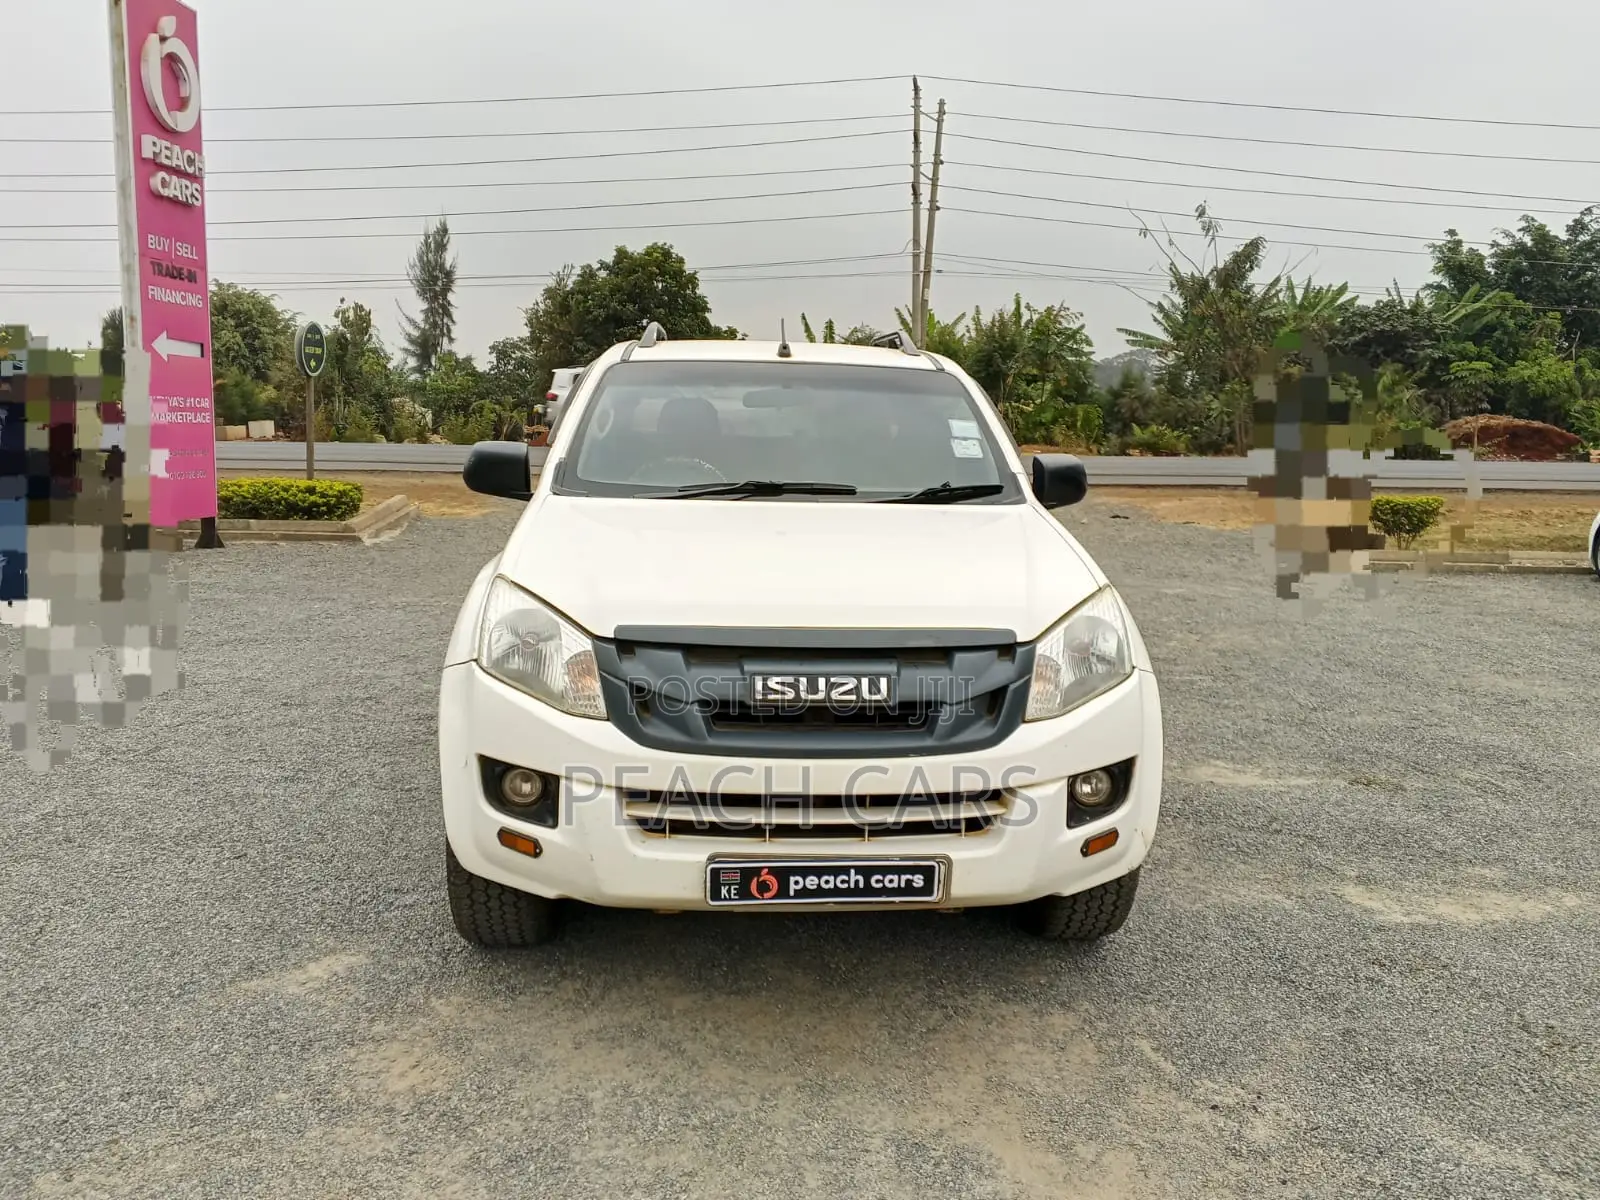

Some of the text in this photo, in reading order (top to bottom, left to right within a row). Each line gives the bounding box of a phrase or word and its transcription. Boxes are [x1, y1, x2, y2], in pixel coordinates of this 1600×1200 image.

[141, 134, 206, 178] PEACH
[149, 171, 202, 207] CARS
[147, 233, 199, 260] BUY SELL
[149, 260, 198, 284] TRADE-IN
[147, 285, 203, 308] FINANCING
[195, 398, 210, 409] CAR
[754, 675, 890, 701] ISUZU
[720, 885, 740, 899] KE
[789, 869, 925, 896] peach cars
